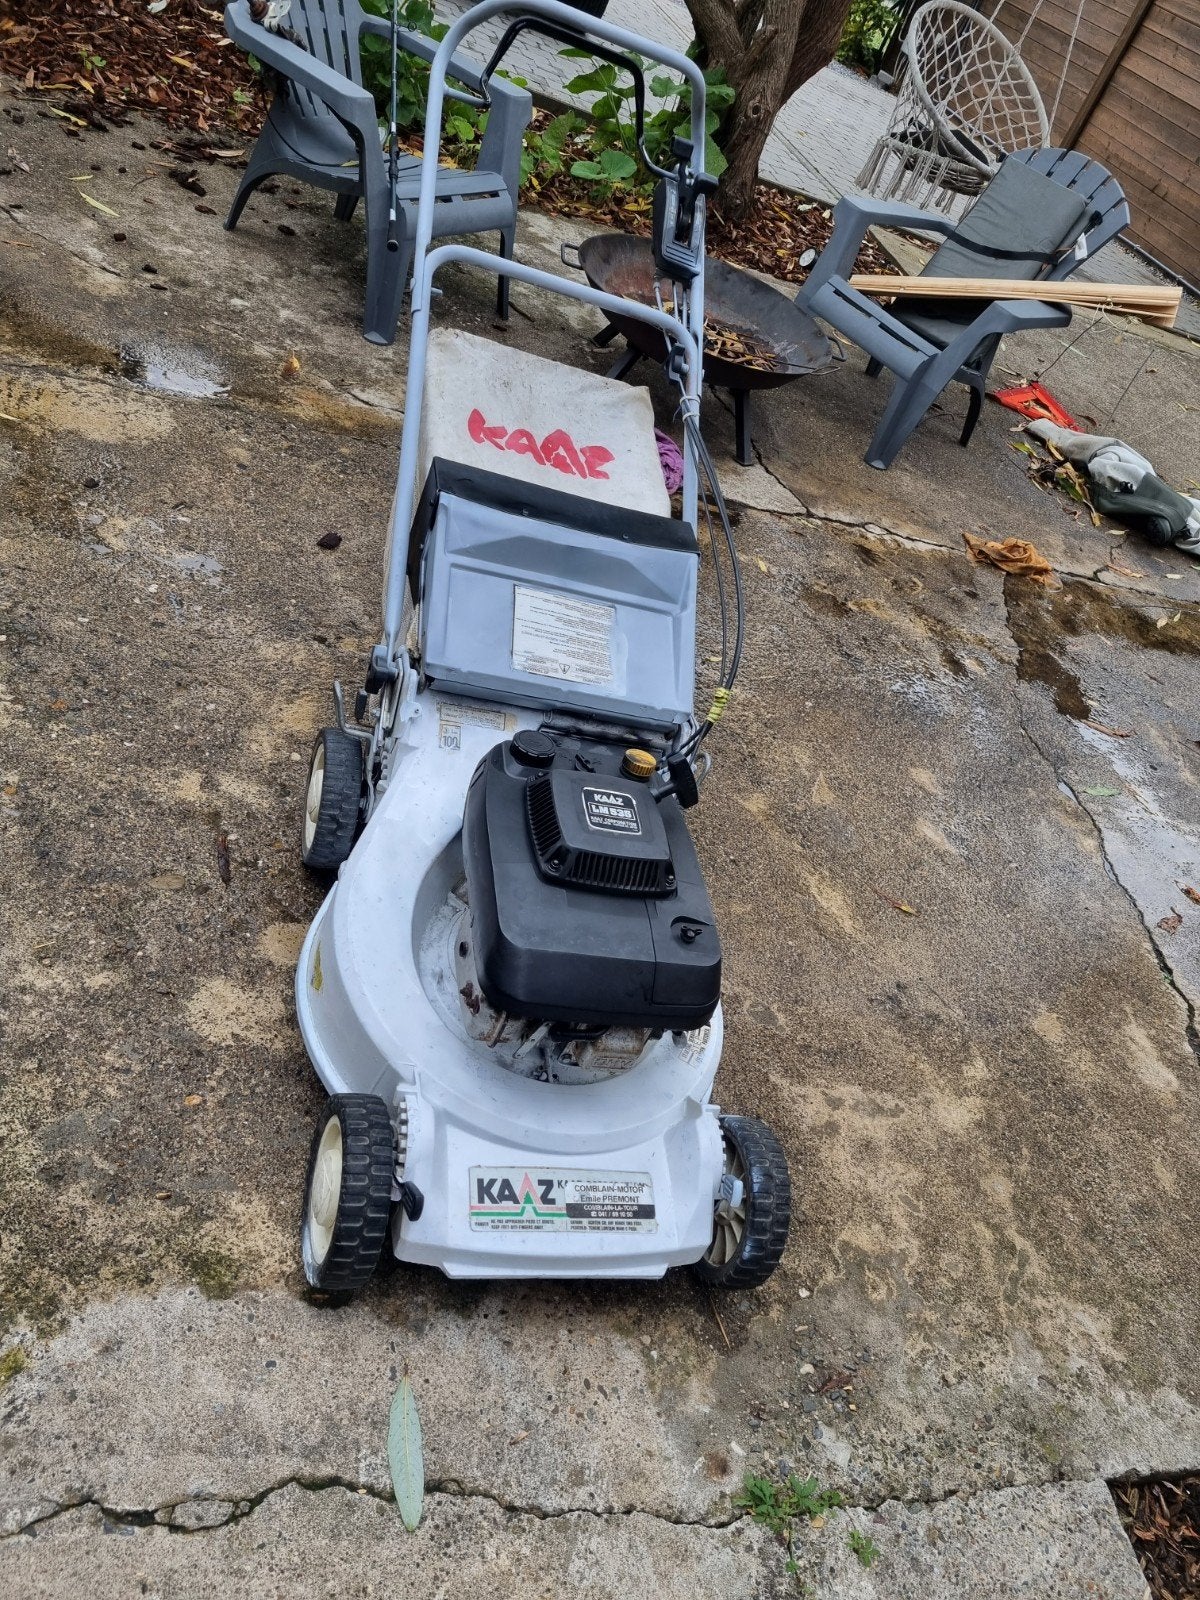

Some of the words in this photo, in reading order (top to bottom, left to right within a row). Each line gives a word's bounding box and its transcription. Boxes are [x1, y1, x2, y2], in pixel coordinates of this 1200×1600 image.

[593, 793, 624, 806] KAAZ
[591, 804, 609, 815] LM
[477, 1172, 556, 1205] KAAZ
[574, 1185, 644, 1194] COMBLAIN-MOTOR
[581, 1194, 601, 1203] Emile
[602, 1195, 640, 1203] PREMONT
